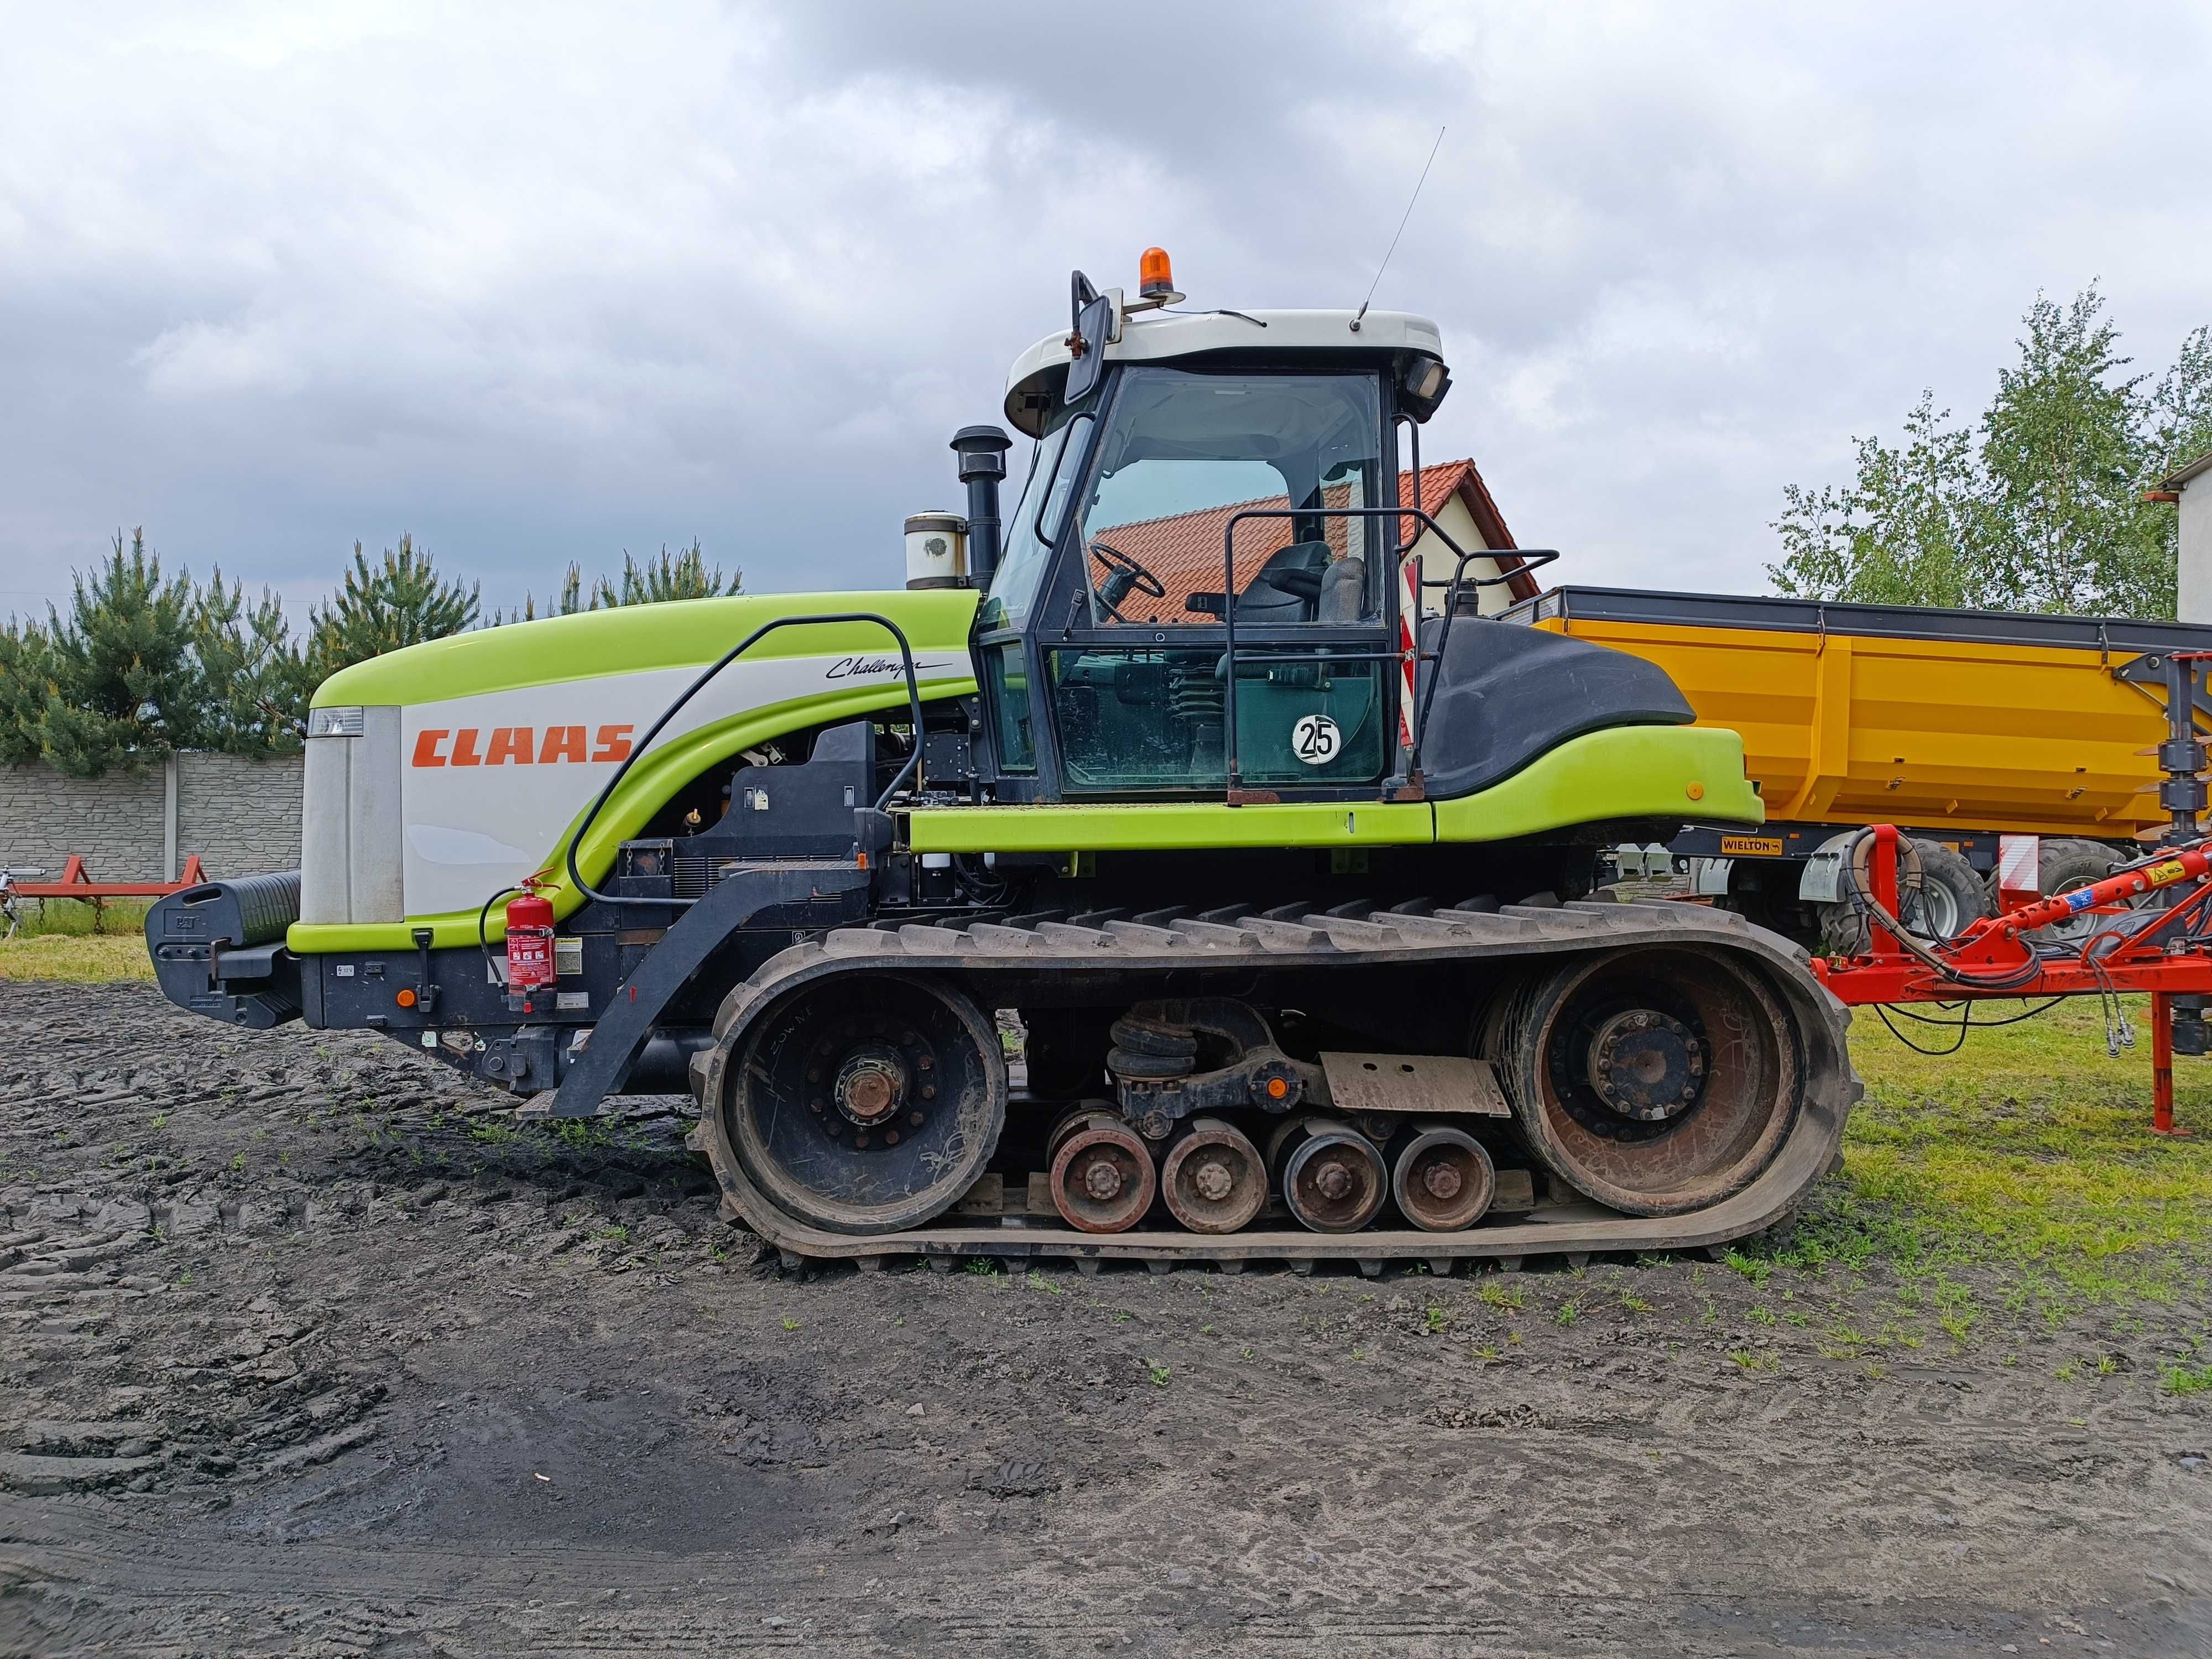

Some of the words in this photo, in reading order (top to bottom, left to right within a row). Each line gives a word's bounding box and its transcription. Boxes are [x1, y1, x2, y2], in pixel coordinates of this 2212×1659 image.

[826, 656, 953, 680] Challengr
[411, 724, 635, 768] CLAAS
[1300, 723, 1332, 755] 25
[1723, 840, 1770, 851] WIELTON
